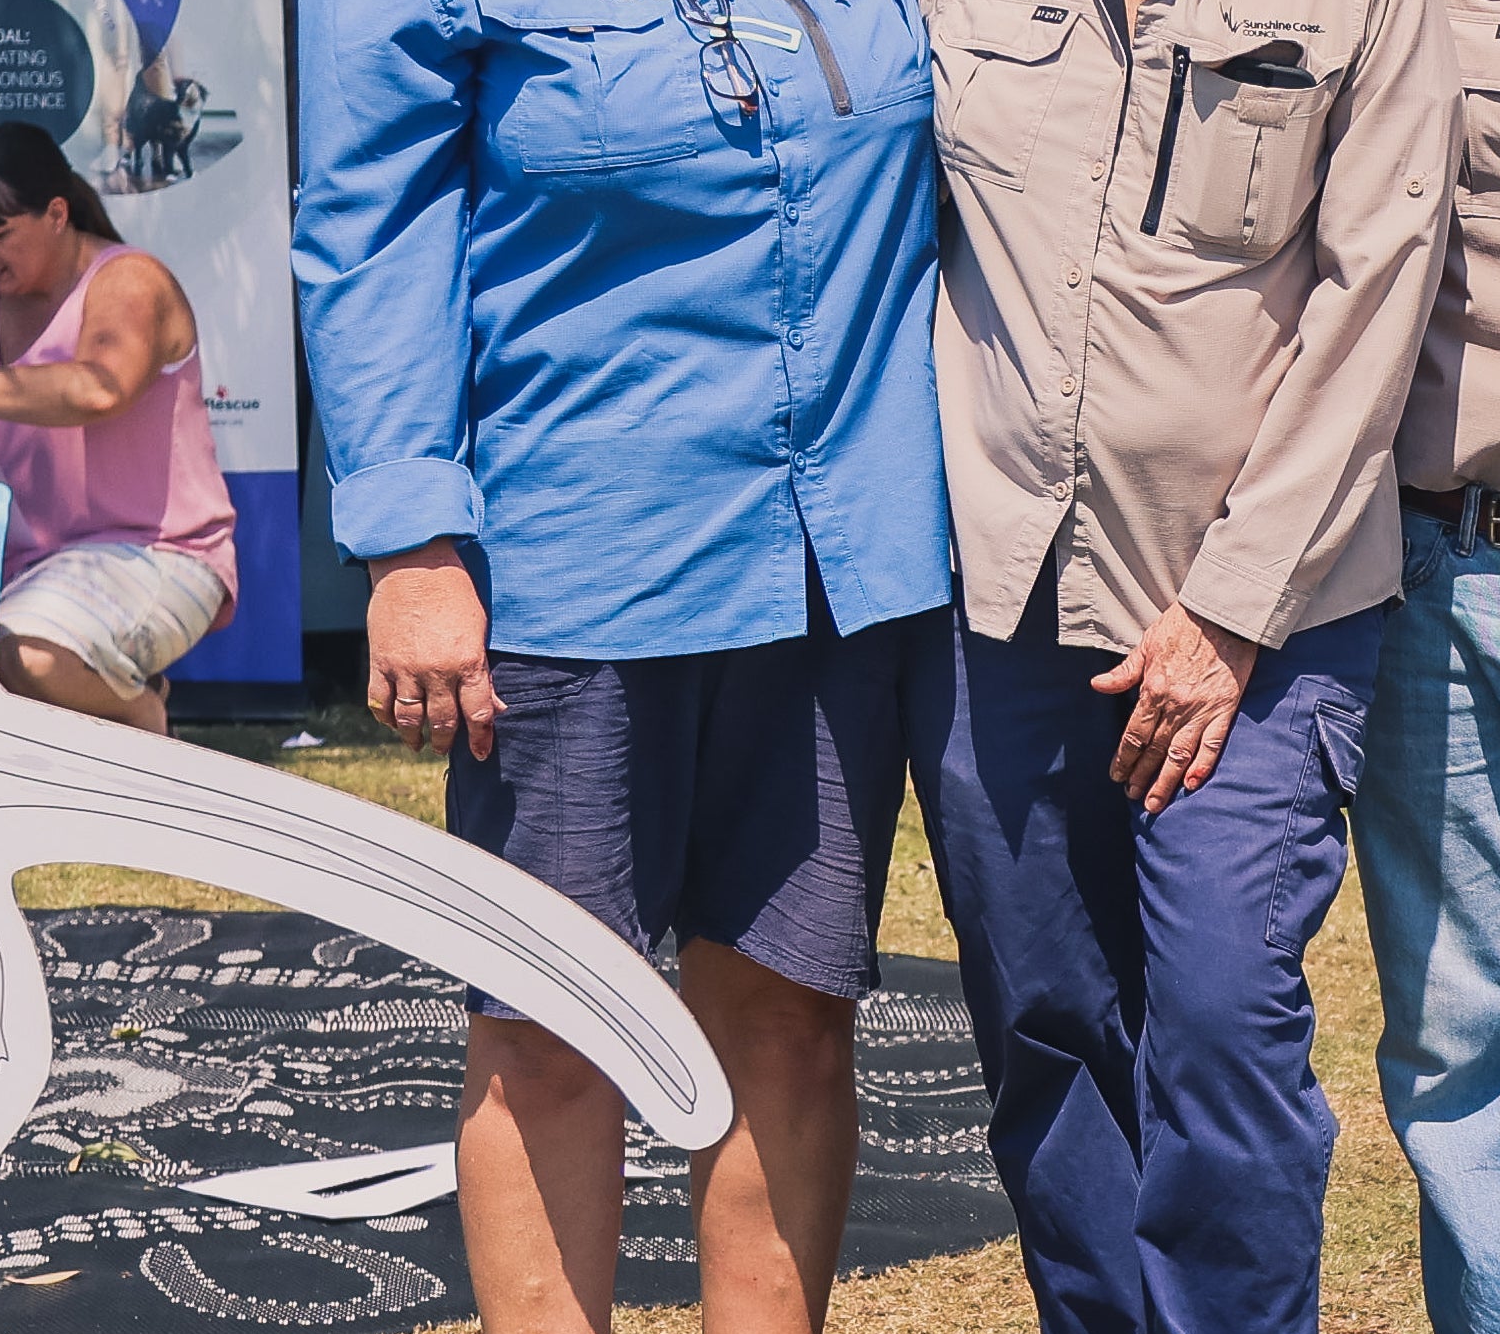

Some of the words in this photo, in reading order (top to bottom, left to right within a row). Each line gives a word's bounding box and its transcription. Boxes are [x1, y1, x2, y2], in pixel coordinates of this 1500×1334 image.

[1243, 19, 1291, 32] Sunshine
[1293, 22, 1321, 34] Coast
[1243, 29, 1279, 39] COUNCIL
